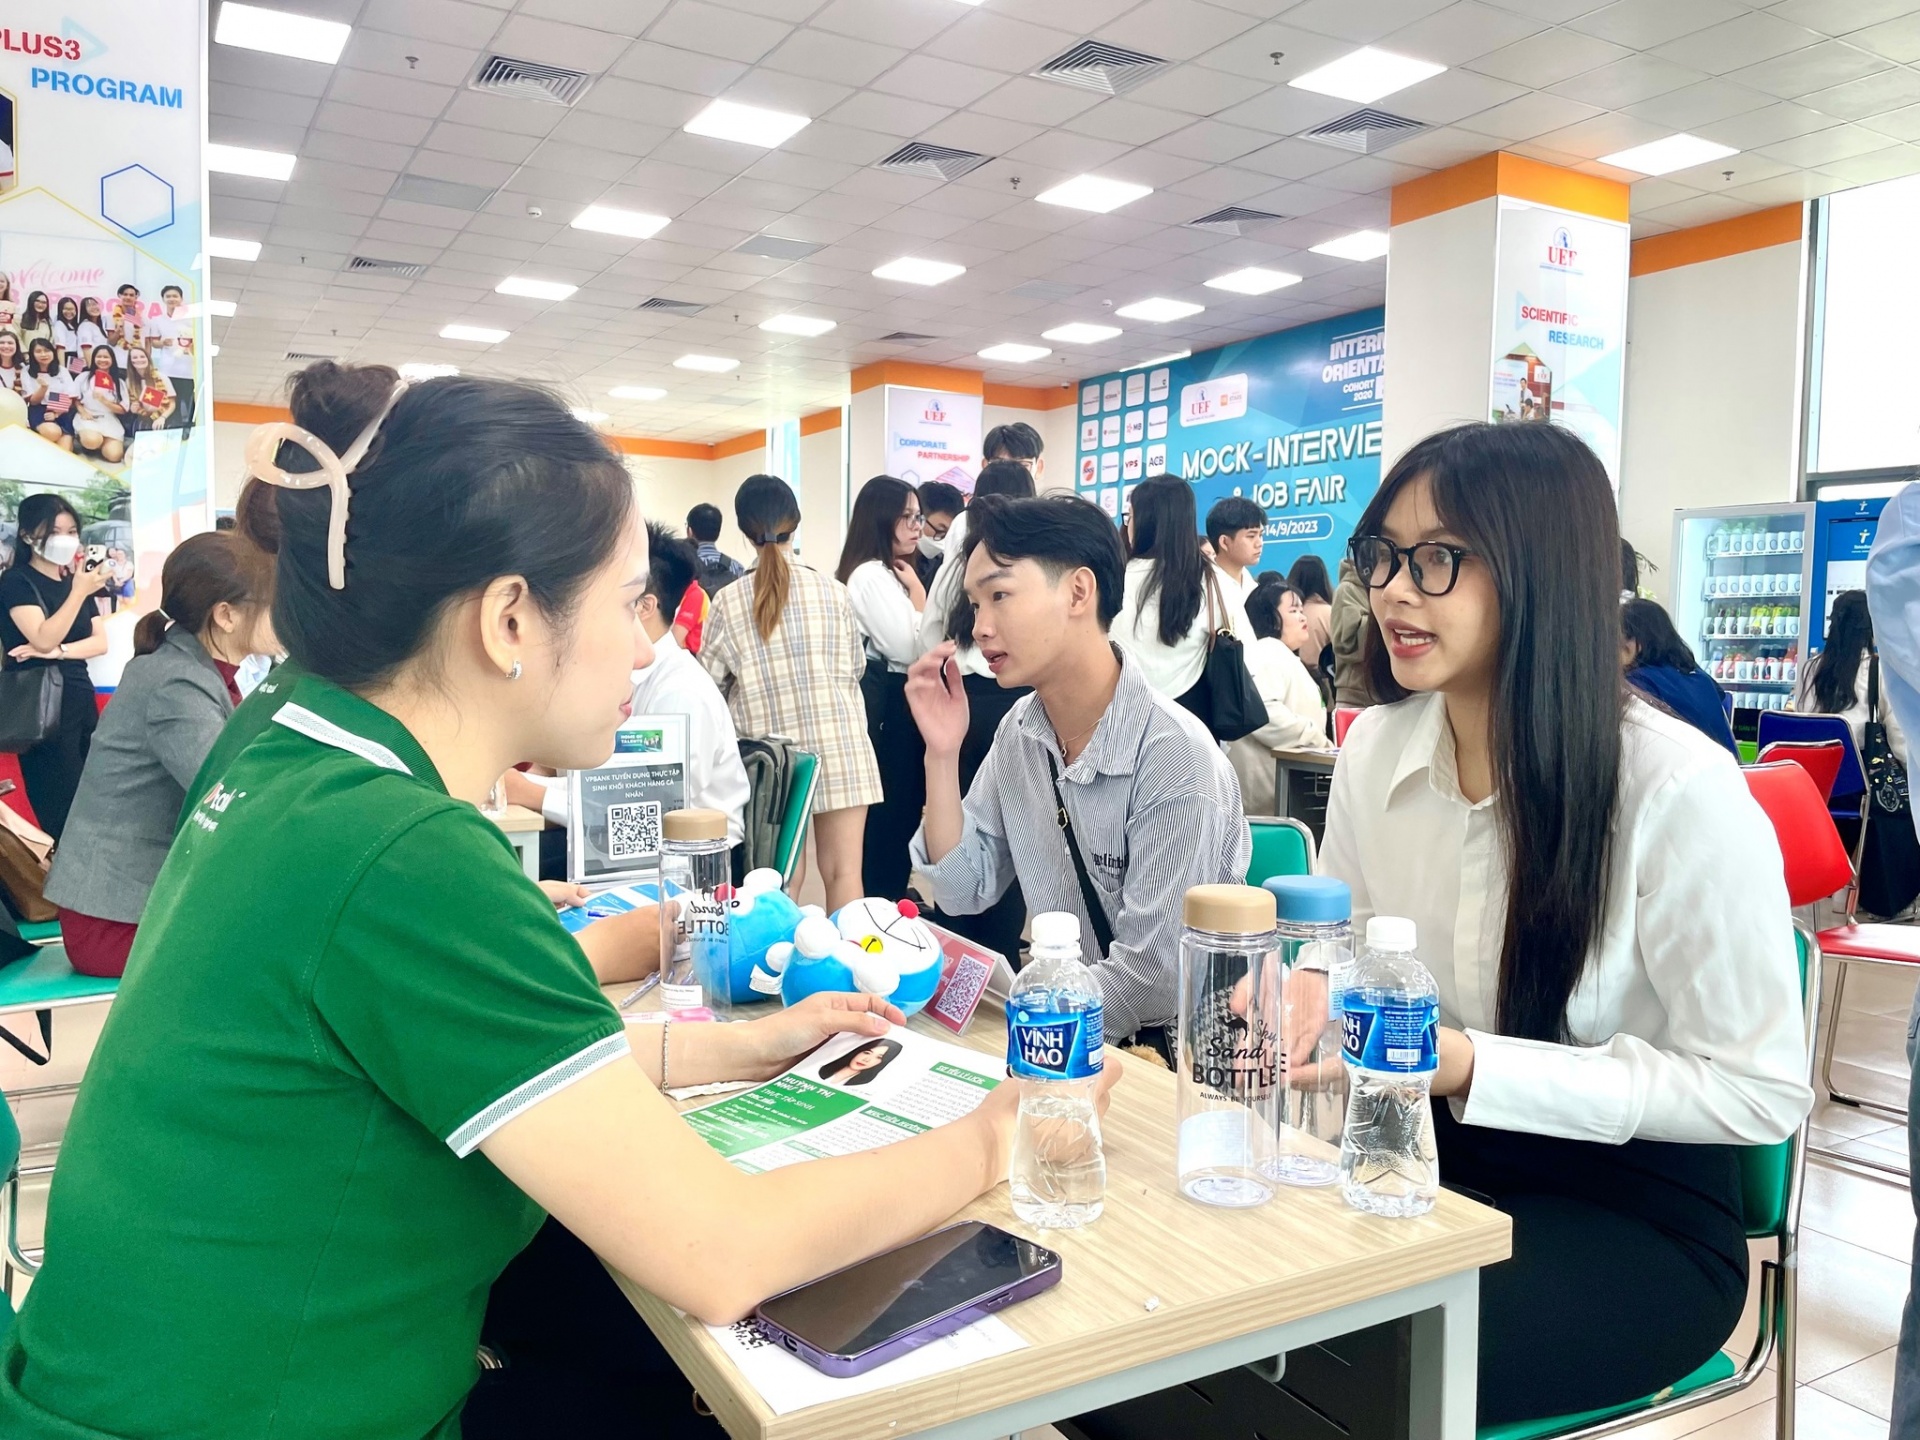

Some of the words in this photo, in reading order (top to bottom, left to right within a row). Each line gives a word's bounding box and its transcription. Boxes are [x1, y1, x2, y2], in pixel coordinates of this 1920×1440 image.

[0, 28, 81, 61] LUS3
[31, 67, 182, 109] PROGRAM
[1548, 246, 1577, 267] UEF
[10, 259, 104, 288] Welcome
[1521, 305, 1579, 327] SCIENTIFIC
[1548, 330, 1604, 350] RESEARCH
[1343, 379, 1375, 394] COHORT
[1353, 389, 1373, 401] 2020
[1192, 400, 1211, 415] UEF
[925, 410, 946, 422] UEF
[1133, 422, 1142, 431] MB
[899, 437, 947, 450] CORPORATE
[917, 451, 970, 463] PARTNERSHIP
[1148, 455, 1164, 467] ACB
[1294, 474, 1345, 506] FAIR
[585, 775, 610, 783] VPBANK
[592, 784, 607, 792] SINH
[1021, 1026, 1064, 1048] VĨNH
[1206, 1036, 1264, 1060] Sand
[1193, 1063, 1276, 1089] BOTTLE
[1200, 1092, 1227, 1102] ALWAYS
[1244, 1093, 1271, 1102] YOURSELF
